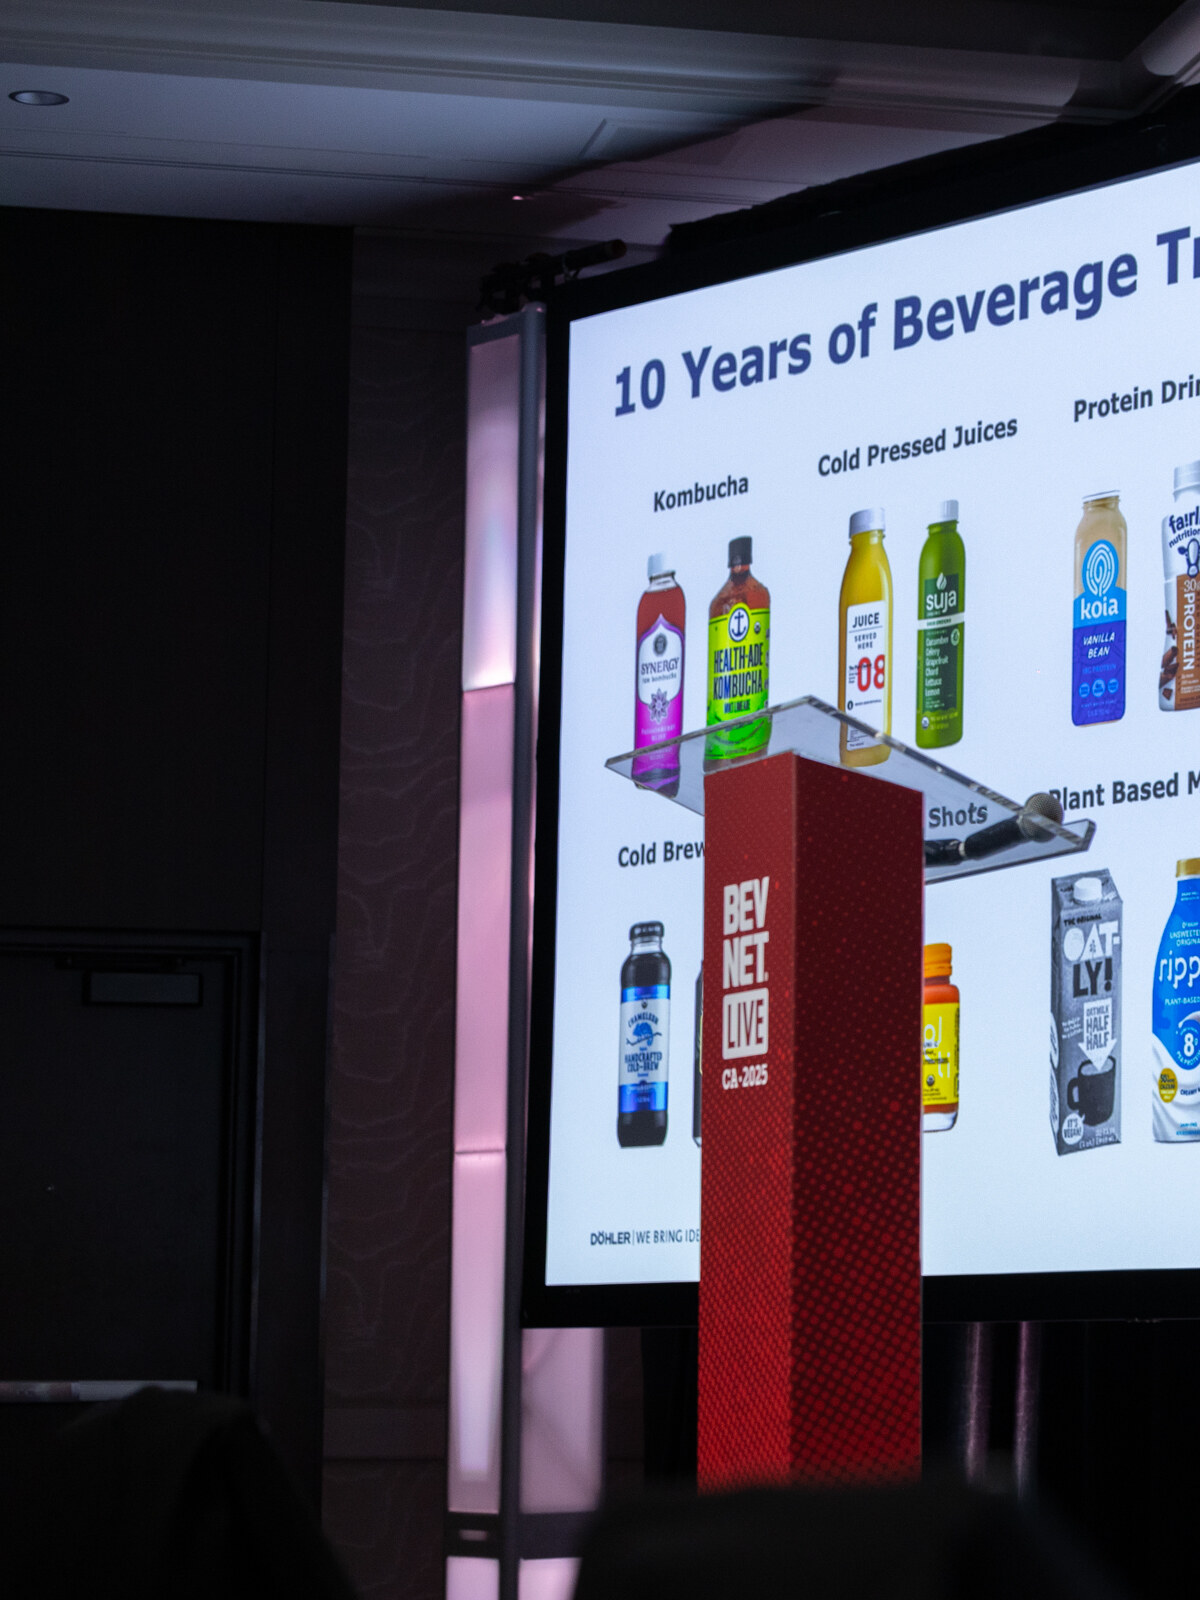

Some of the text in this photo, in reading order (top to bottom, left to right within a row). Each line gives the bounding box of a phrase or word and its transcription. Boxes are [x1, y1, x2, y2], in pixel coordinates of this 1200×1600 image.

[614, 357, 667, 418] 10
[680, 331, 812, 400] Years
[826, 302, 878, 367] of
[892, 252, 1138, 351] Beverage
[1071, 387, 1154, 424] Protein
[817, 414, 1019, 477] Cold Pressed Juices
[652, 473, 750, 514] Kombucha
[925, 589, 958, 614] suja
[1080, 596, 1119, 621] koia
[852, 611, 880, 629] JUICE
[854, 631, 877, 643] SERVED
[925, 635, 949, 648] Cucumber
[1083, 631, 1116, 646] VANILLA
[1182, 592, 1196, 672] PROTEIN
[857, 641, 873, 650] HERE
[1087, 645, 1110, 660] BEAN
[640, 656, 680, 676] SYNERGY
[713, 642, 764, 675] HEALTH-ADE
[925, 655, 949, 669] Grapefruit
[857, 653, 886, 692] 08
[712, 669, 764, 701] KOMBUCHA
[924, 687, 941, 698] Lemon
[1048, 784, 1105, 812] Plant
[1111, 772, 1181, 806] Based
[928, 803, 988, 829] Shots
[617, 840, 705, 868] Cold Brew
[723, 876, 770, 936] BEV
[1072, 958, 1113, 998] LY!
[1164, 996, 1200, 1007] PLANT-BASED
[627, 1011, 660, 1029] CHAMELEON
[726, 995, 766, 1050] LIVE
[1086, 1015, 1110, 1034] HALF
[1086, 1031, 1110, 1051] HALF
[624, 1051, 663, 1064] HANDCRAFTED
[626, 1061, 660, 1074] COLD-BREW
[589, 1228, 700, 1246] DÖHLER WE BRING IDE
